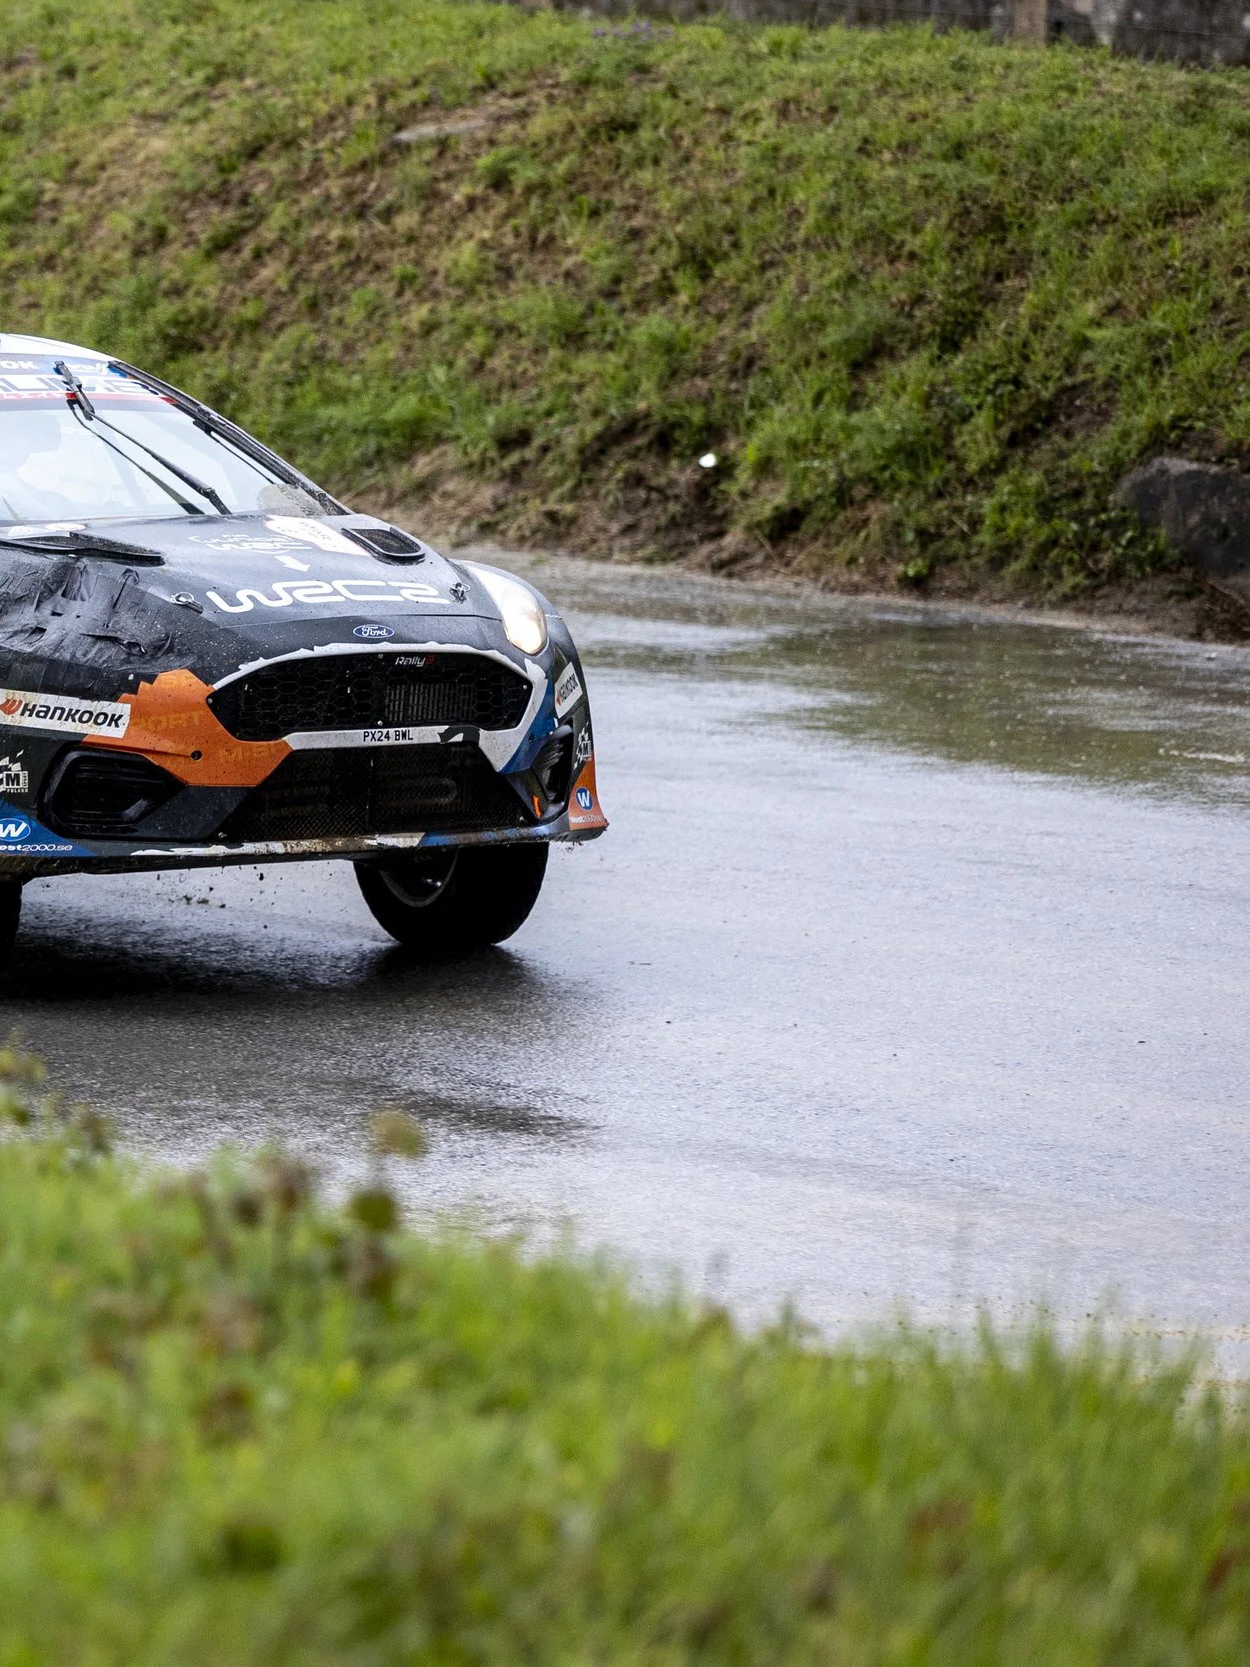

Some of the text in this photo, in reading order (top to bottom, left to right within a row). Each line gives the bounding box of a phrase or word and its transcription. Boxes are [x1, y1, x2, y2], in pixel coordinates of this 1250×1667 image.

[206, 580, 451, 613] WRC2
[361, 624, 389, 638] Ford
[363, 730, 414, 743] PX24 BWL
